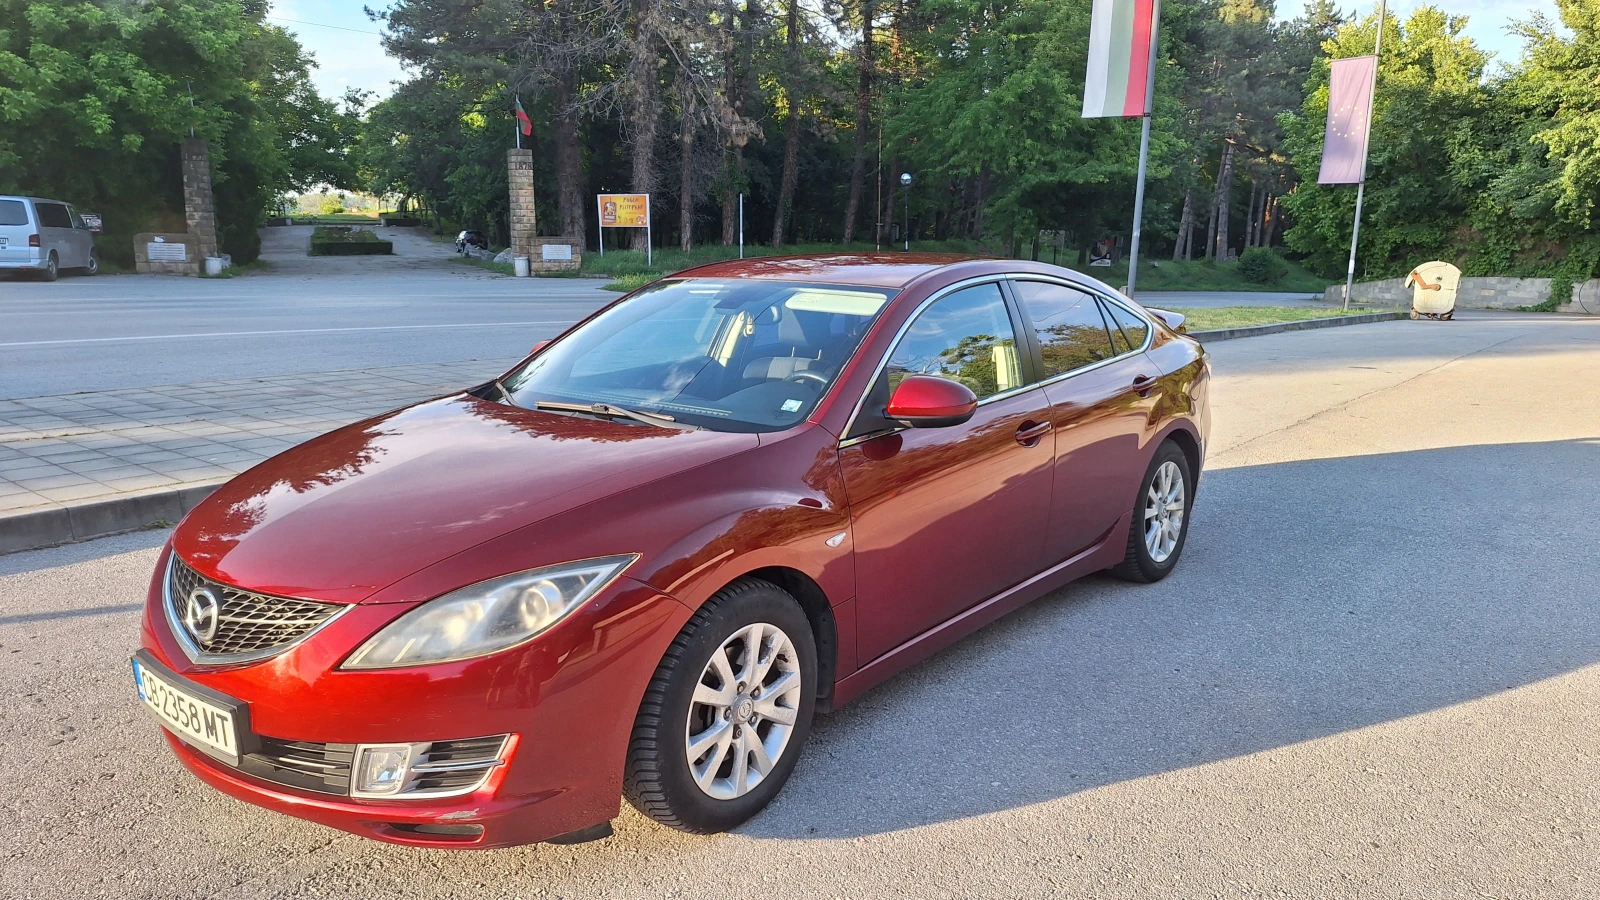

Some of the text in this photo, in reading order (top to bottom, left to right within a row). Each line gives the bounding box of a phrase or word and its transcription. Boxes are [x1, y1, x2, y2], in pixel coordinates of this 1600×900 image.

[514, 162, 532, 170] 1878
[142, 671, 228, 747] CB 2358 MT
